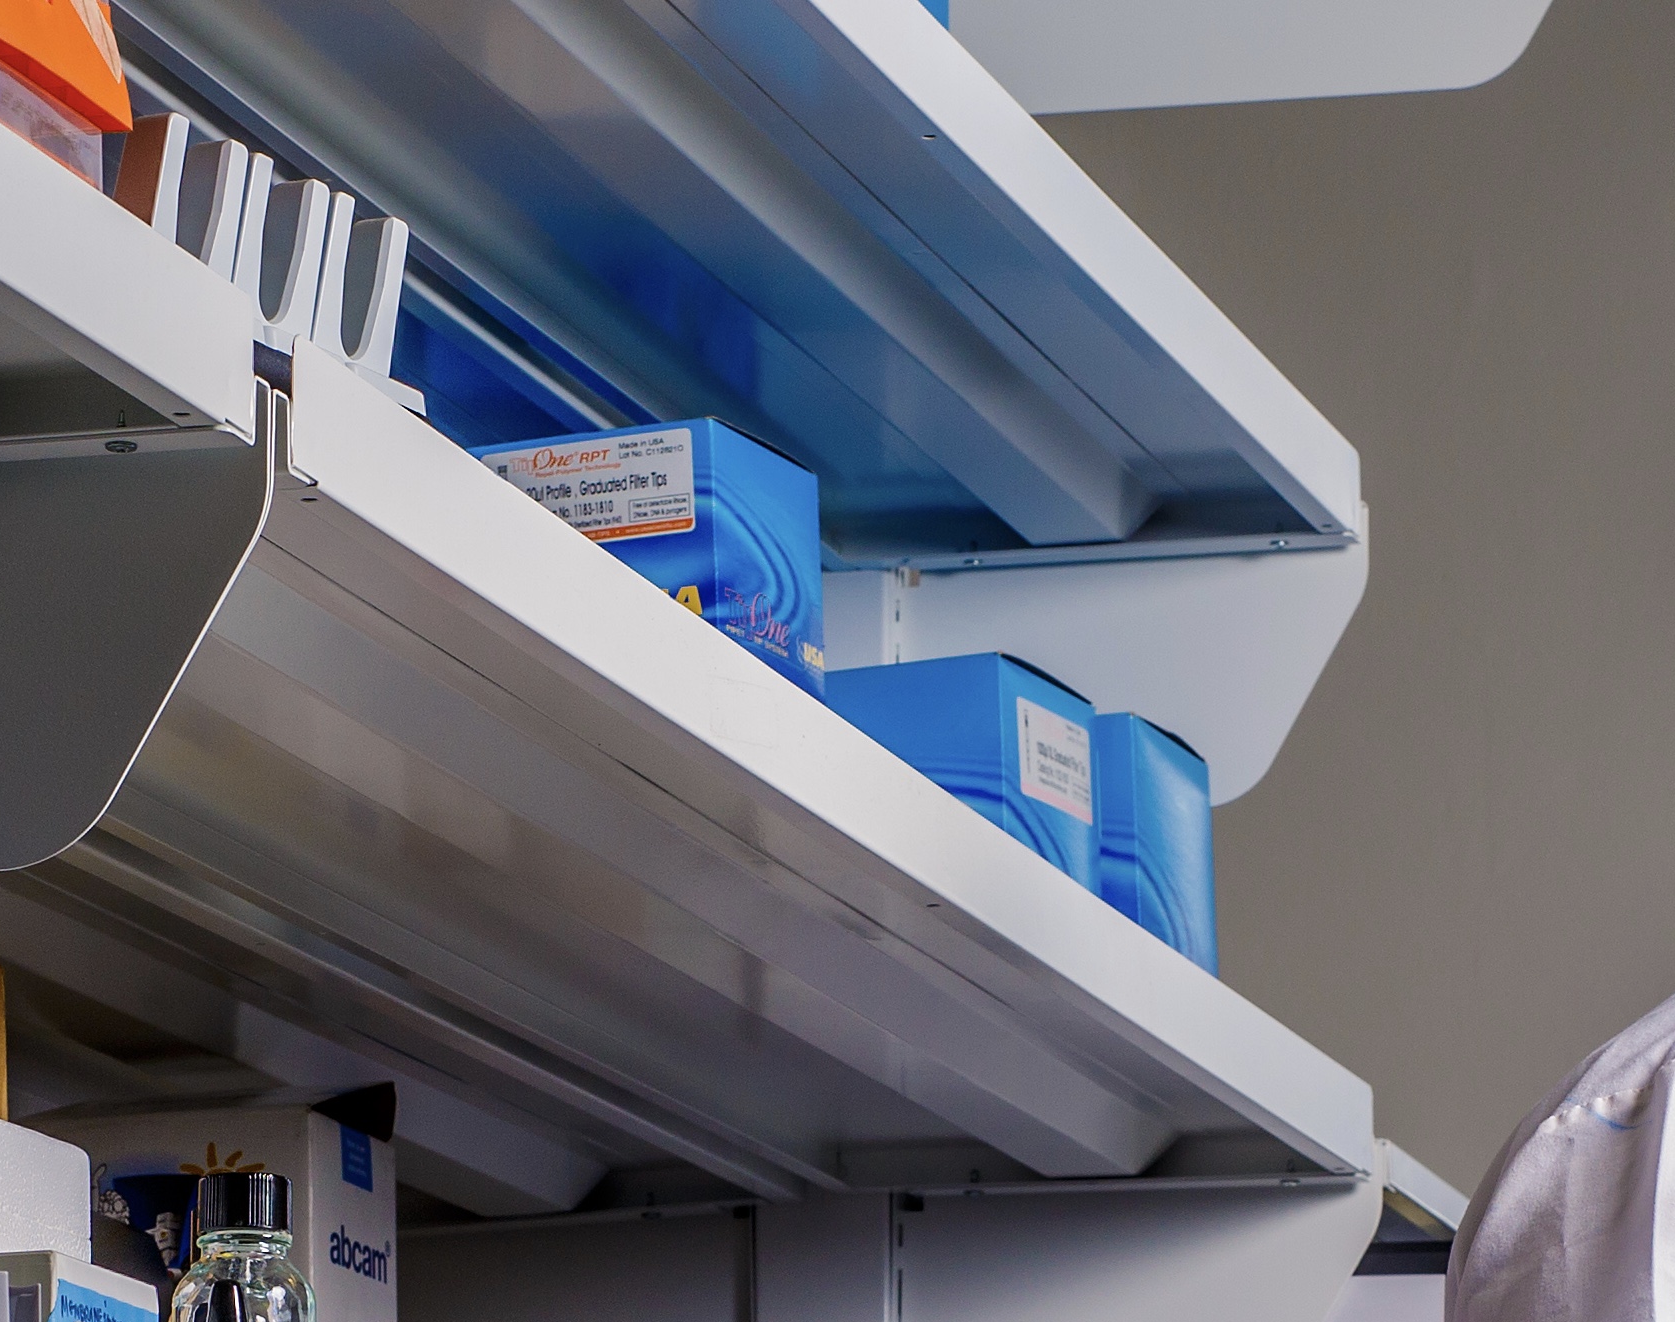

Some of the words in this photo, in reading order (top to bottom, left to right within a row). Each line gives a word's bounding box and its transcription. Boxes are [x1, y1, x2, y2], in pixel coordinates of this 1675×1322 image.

[618, 440, 639, 450] Made
[648, 437, 665, 447] USA
[579, 449, 611, 465] RPT
[545, 483, 572, 501] Profile
[579, 477, 628, 497] Graduated
[629, 473, 650, 491] Filter
[650, 471, 668, 491] Tips
[574, 500, 615, 516] 1183-1810
[803, 641, 825, 671] USA
[330, 1224, 387, 1284] abcam
